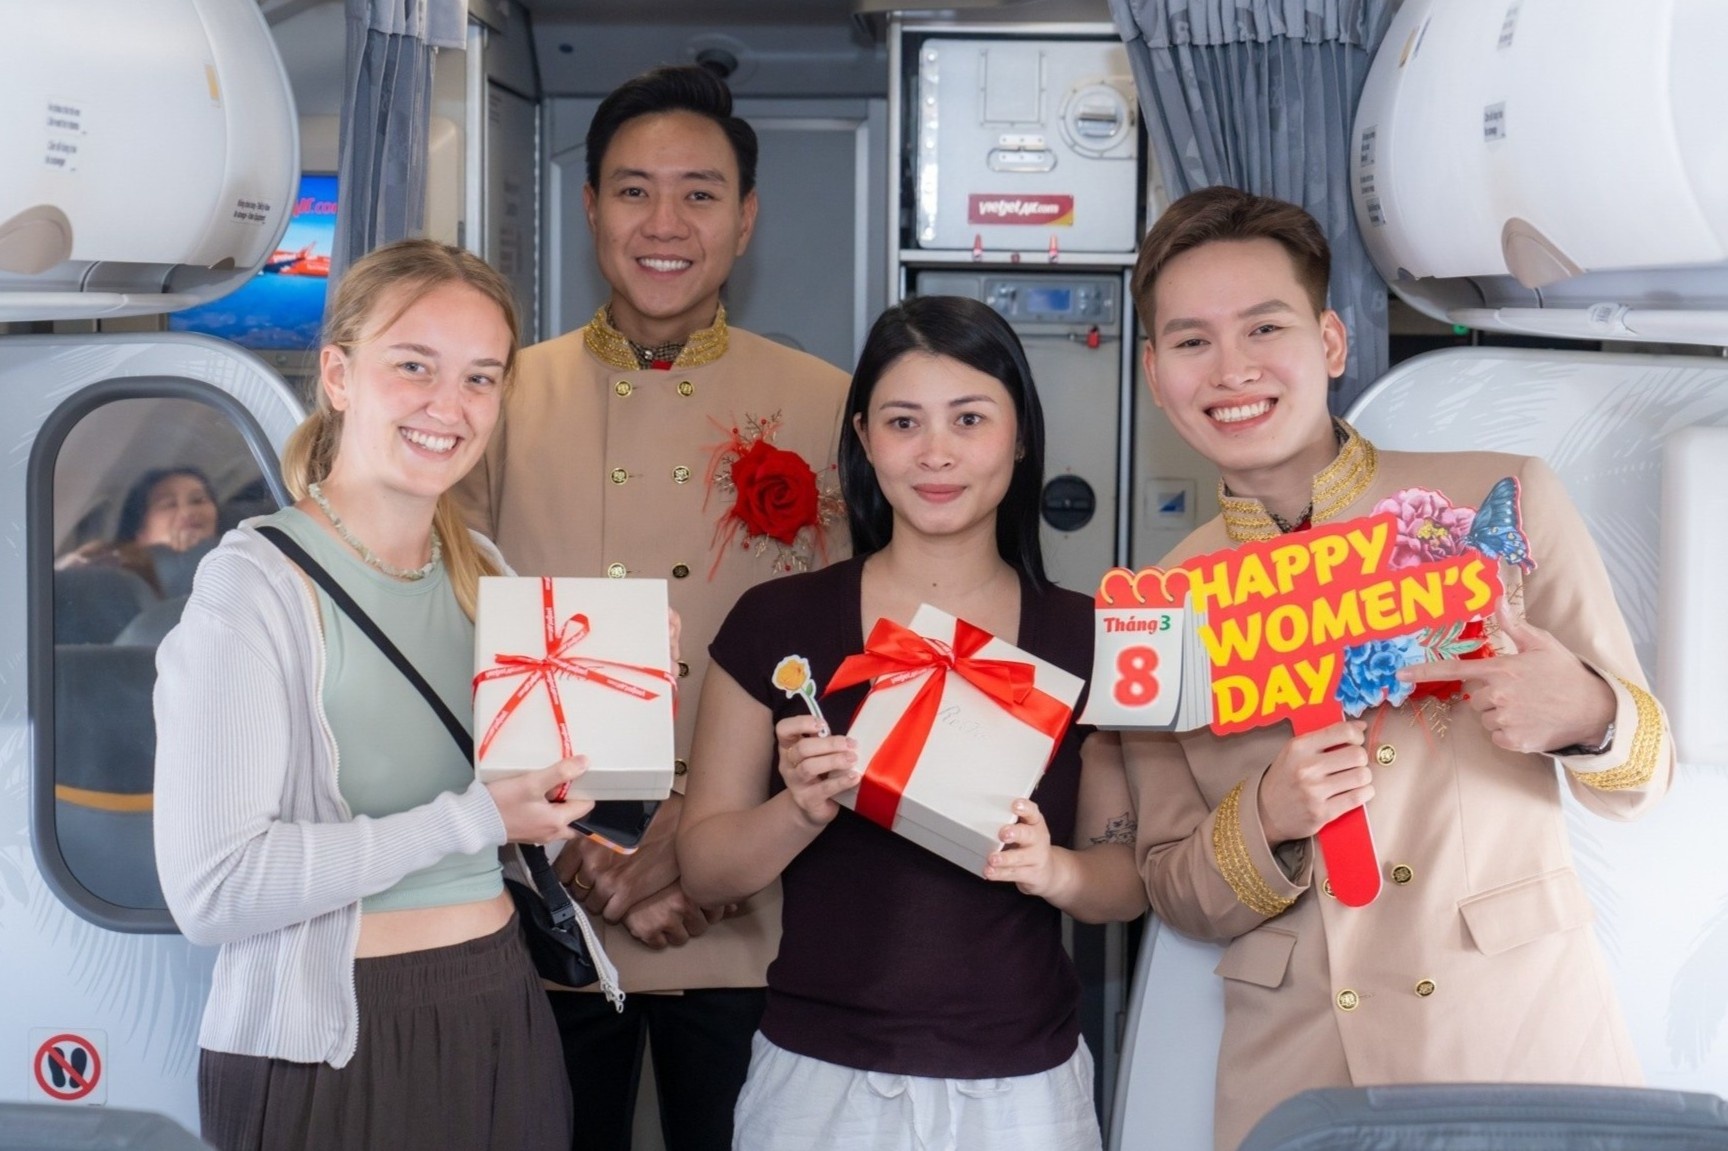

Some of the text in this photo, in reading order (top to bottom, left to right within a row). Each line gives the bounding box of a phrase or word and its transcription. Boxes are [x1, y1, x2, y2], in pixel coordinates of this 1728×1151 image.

[1186, 523, 1389, 613] HAPPY
[1103, 614, 1172, 635] Tháng 3
[1198, 558, 1492, 667] WOMEN'S
[1114, 646, 1160, 708] 8
[1212, 653, 1336, 725] DAY
